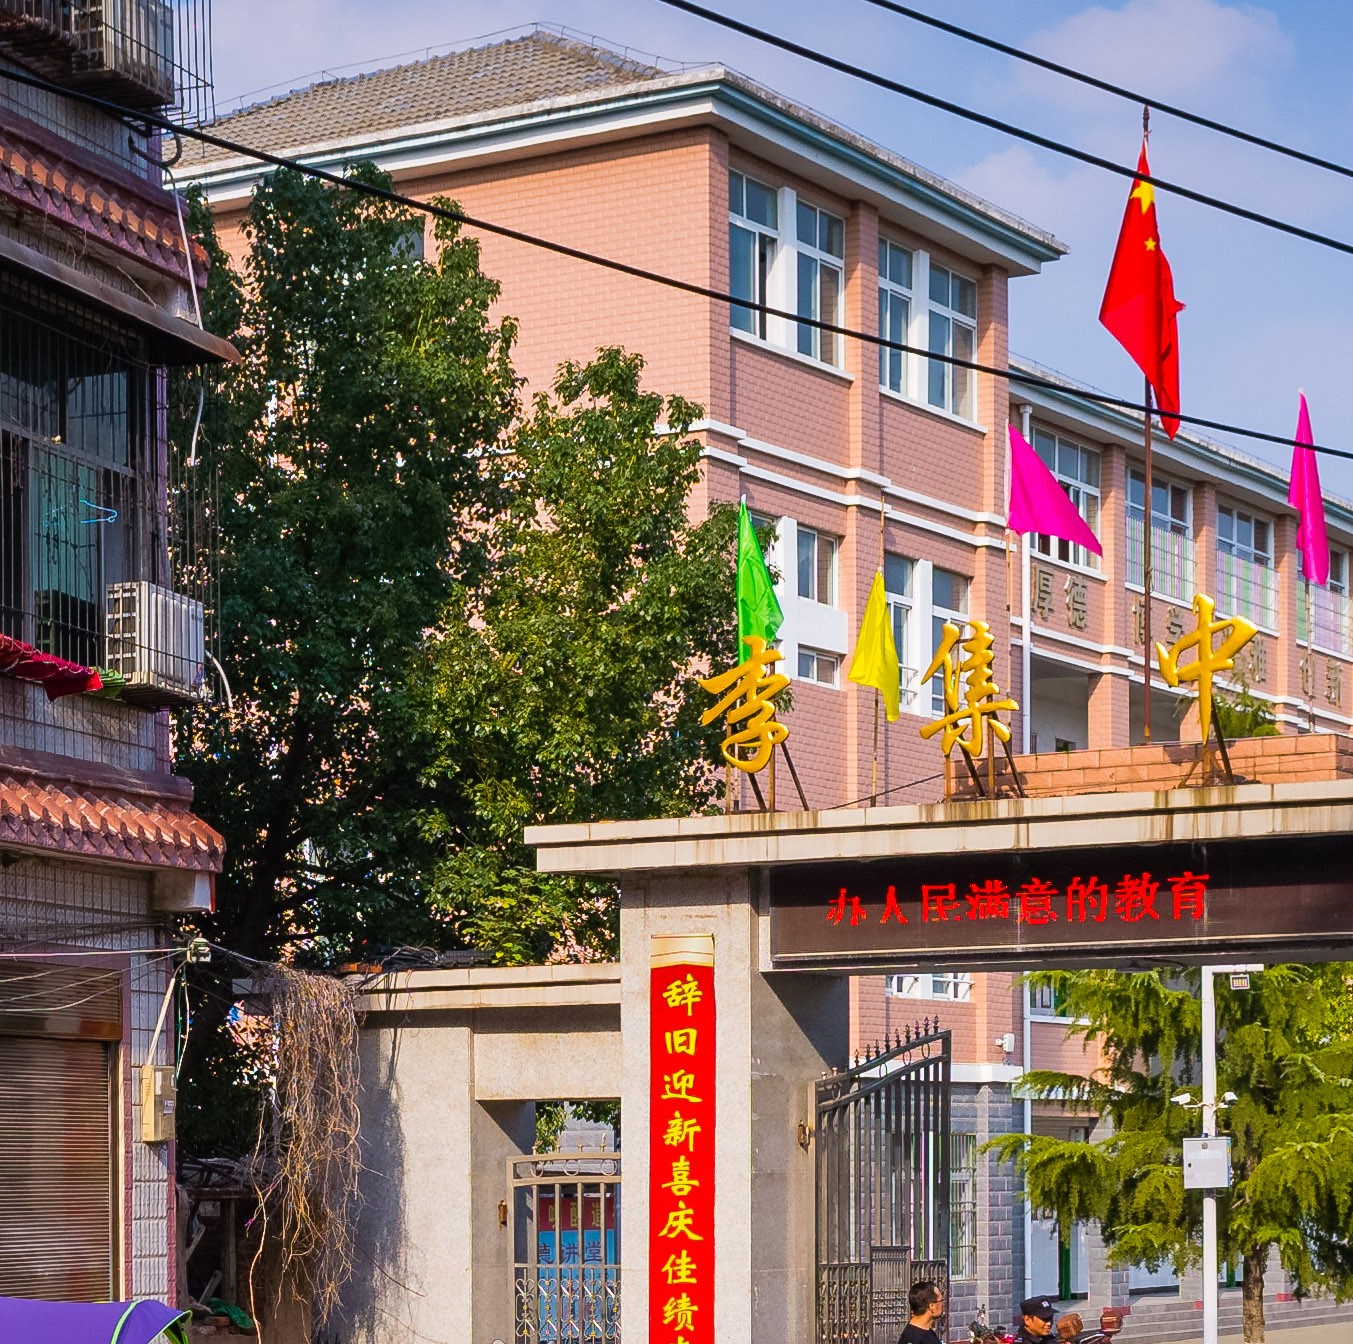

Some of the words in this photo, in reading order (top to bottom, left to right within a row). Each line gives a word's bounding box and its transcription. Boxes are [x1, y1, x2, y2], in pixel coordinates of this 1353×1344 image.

[826, 872, 1211, 927] 办人民满意的教育
